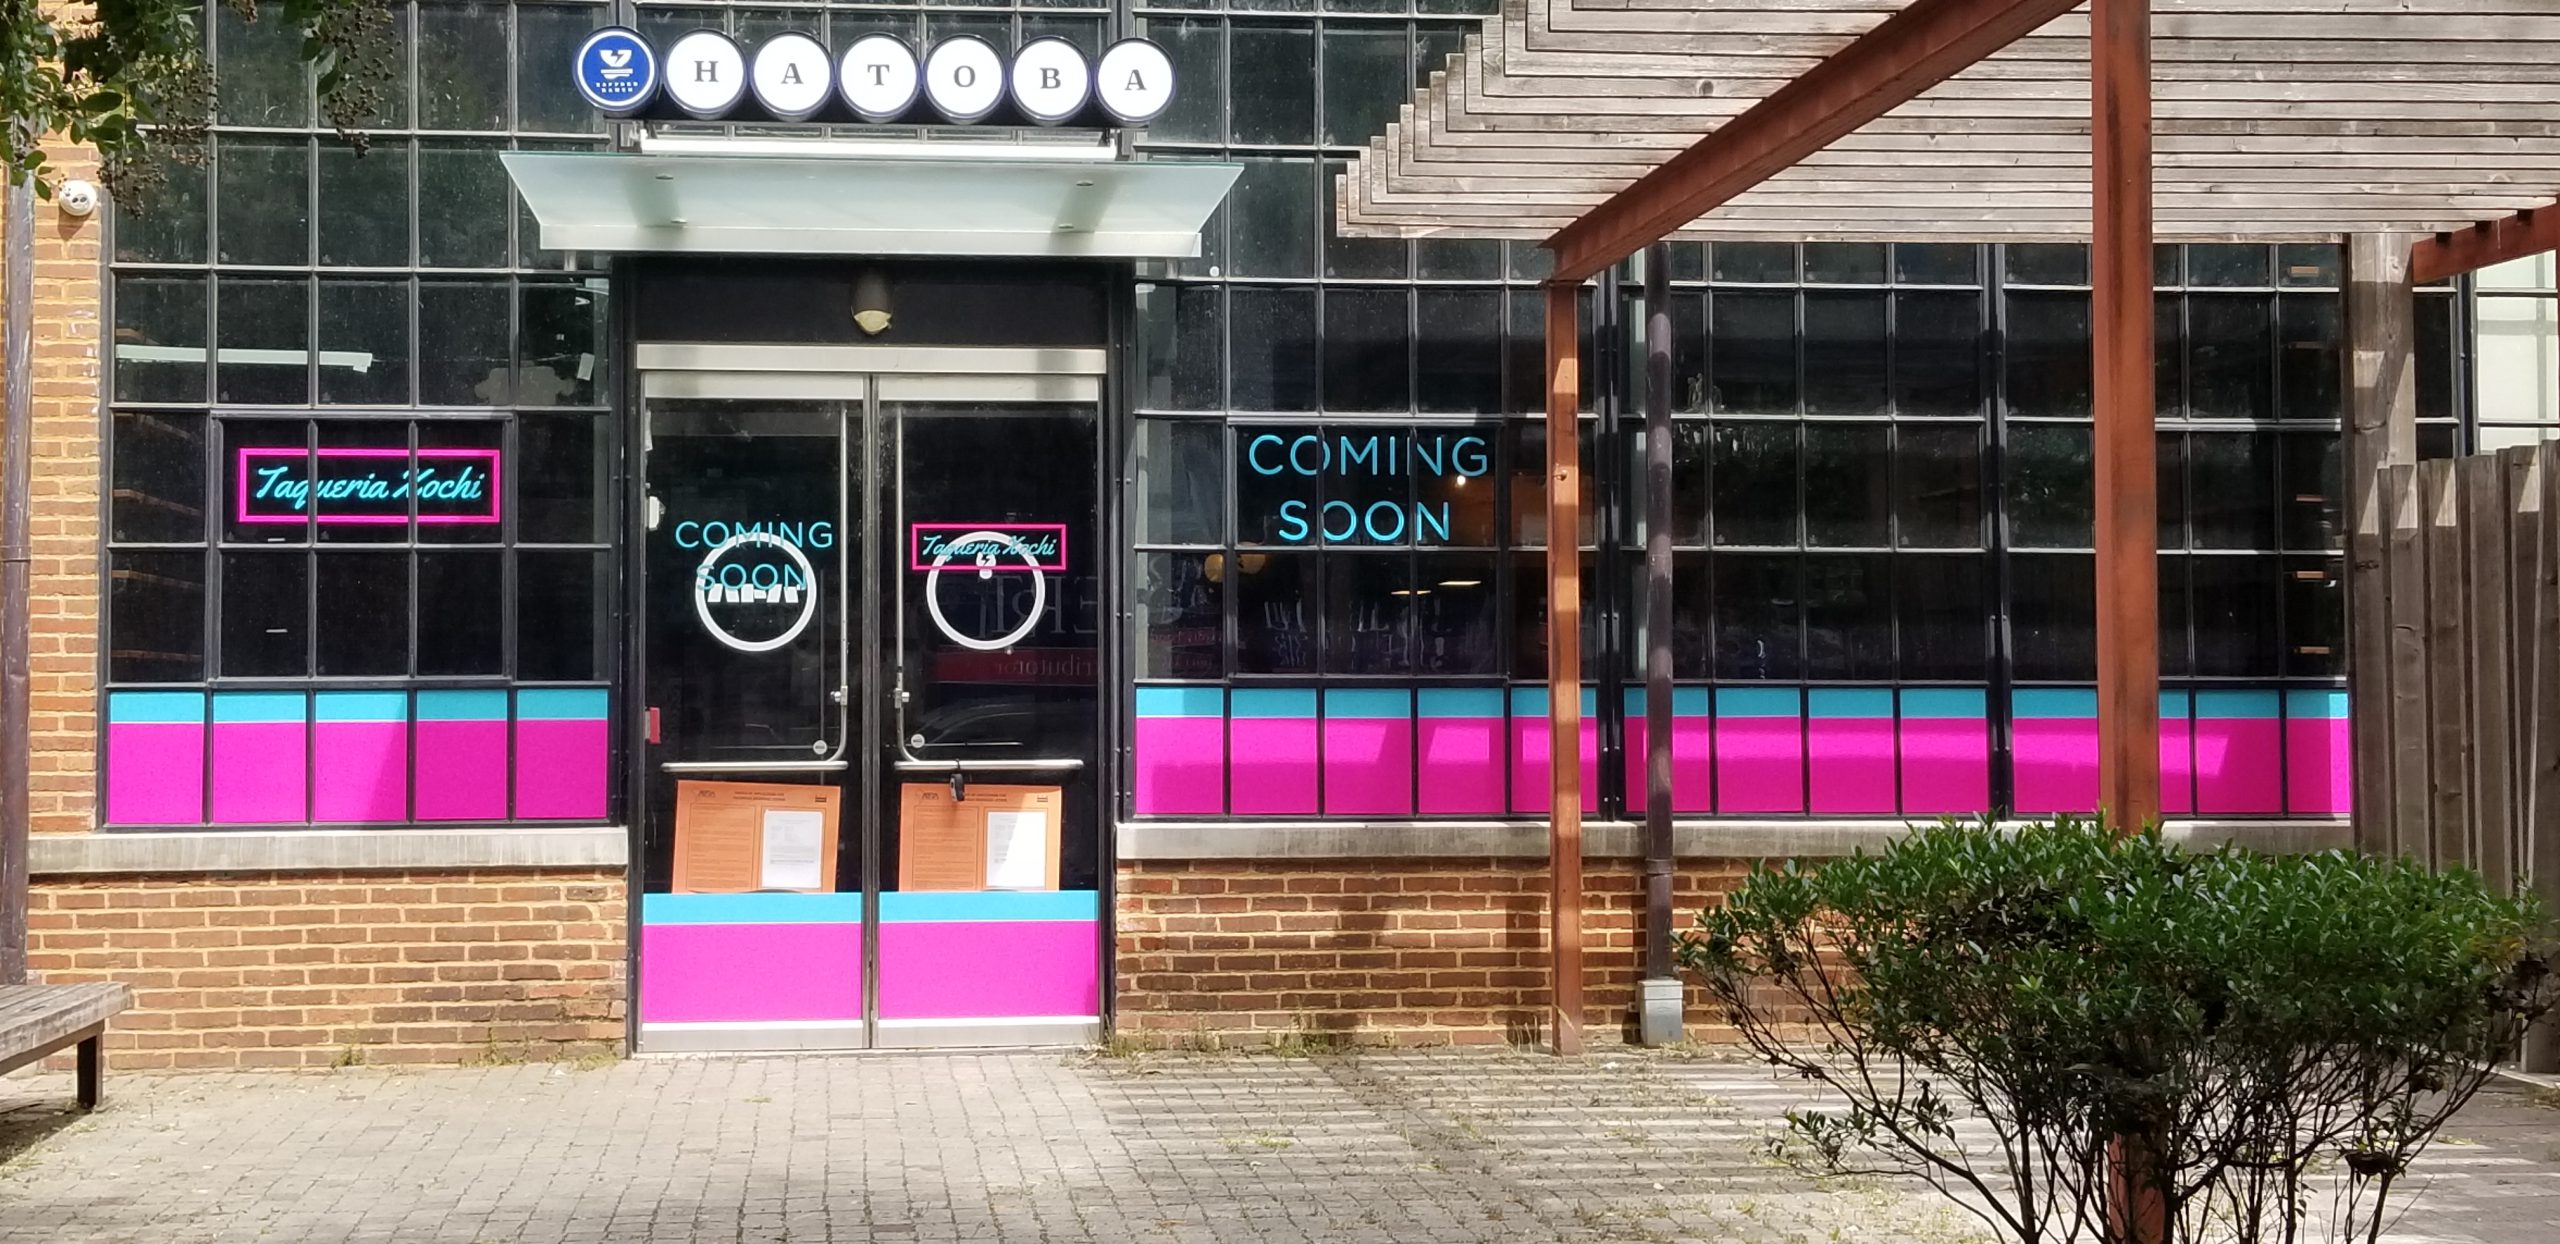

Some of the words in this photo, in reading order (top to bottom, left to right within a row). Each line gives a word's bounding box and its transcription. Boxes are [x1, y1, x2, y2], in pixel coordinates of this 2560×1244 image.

[1248, 434, 1487, 477] COMING
[255, 465, 390, 510] Taqueria
[392, 465, 486, 499] Xochi
[675, 521, 833, 549] COMING
[1278, 500, 1449, 541] SOON
[922, 535, 1001, 562] Taqueria
[1002, 534, 1058, 556] Xochi
[696, 563, 808, 591] SOON
